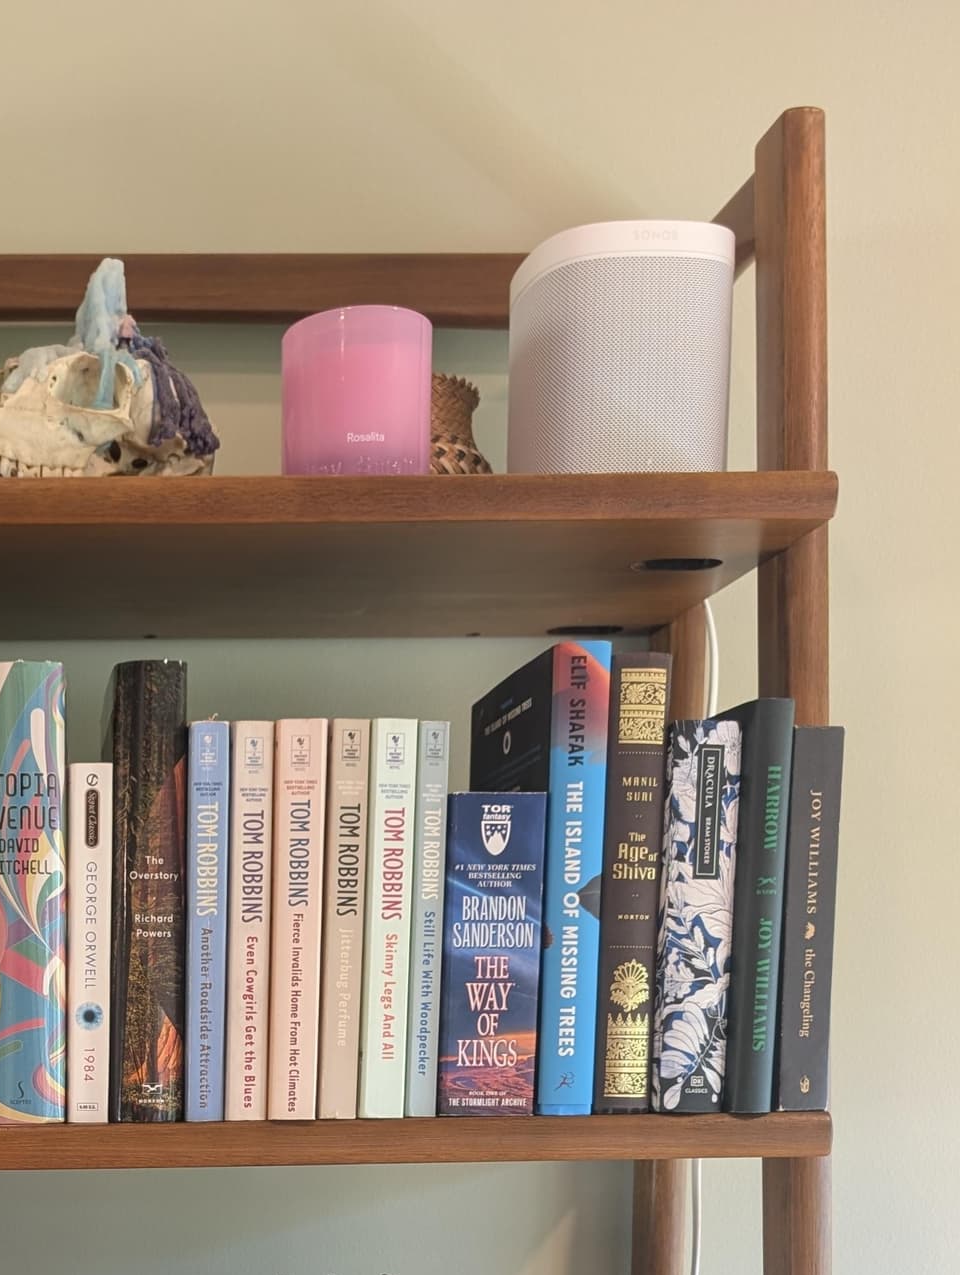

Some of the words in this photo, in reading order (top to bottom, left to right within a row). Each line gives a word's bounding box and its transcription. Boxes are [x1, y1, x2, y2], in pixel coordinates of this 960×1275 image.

[347, 432, 384, 443] Rosalita
[571, 655, 586, 691] ELIF
[568, 698, 586, 767] SHAFAK
[567, 781, 583, 809] THE
[810, 790, 822, 821] JOY
[243, 810, 264, 846] TOM
[145, 855, 164, 865] The
[565, 813, 583, 885] ISLAND
[129, 870, 179, 882] Overstory
[807, 826, 821, 914] WILLIAMS
[85, 861, 97, 925] GEORGE
[241, 850, 264, 923] ROBBINS
[462, 896, 526, 922] BRANDON
[563, 892, 579, 917] OF
[246, 936, 257, 965] Even
[453, 923, 534, 948] SANDERSON
[84, 932, 97, 990] ORWELL
[475, 957, 508, 979] THE
[559, 922, 581, 998] MISSING
[805, 949, 816, 970] the
[245, 969, 256, 1022] Cowgirls
[465, 982, 509, 1011] WAY
[799, 972, 816, 1038] Changeling
[245, 1025, 256, 1048] Get
[477, 1014, 499, 1036] OF
[558, 1003, 576, 1057] TREES
[84, 1047, 95, 1082] 1984
[245, 1051, 253, 1070] the
[457, 1040, 517, 1066] KINGS
[243, 1074, 253, 1109] Blues
